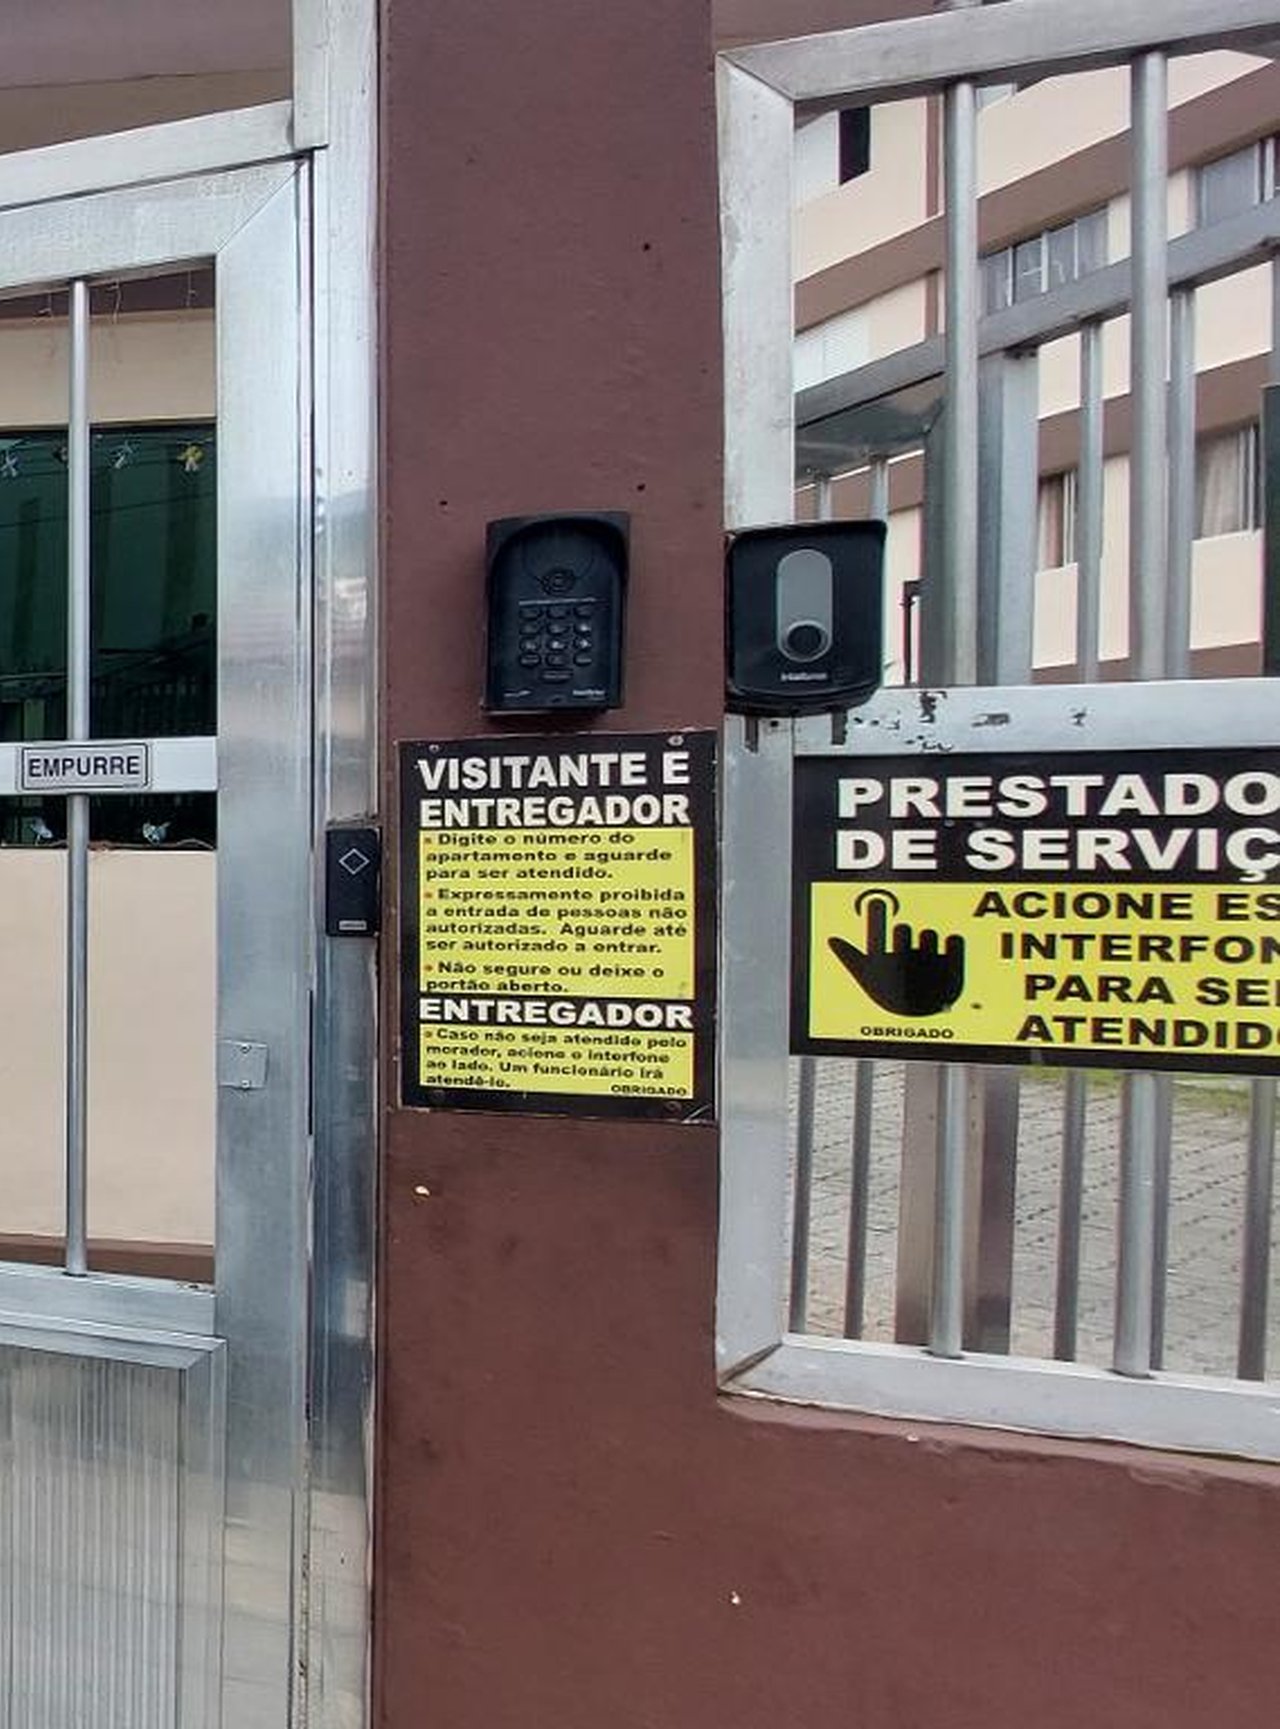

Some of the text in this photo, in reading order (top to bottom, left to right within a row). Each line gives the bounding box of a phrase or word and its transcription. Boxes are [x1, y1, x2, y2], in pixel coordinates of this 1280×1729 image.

[28, 756, 140, 777] EMPURRE
[418, 752, 690, 790] VISITANTE E
[837, 772, 1280, 818] PRESTADO
[420, 795, 690, 827] ENTREGADOR
[438, 832, 635, 846] Digite o número do
[426, 851, 557, 864] apartamento
[584, 850, 672, 863] aguarde
[836, 828, 1280, 882] DE SERVIÇ
[426, 867, 613, 882] para ser atendido.
[438, 889, 685, 903] Expressamente proibida
[426, 907, 687, 920] a entrada de pessoas não
[973, 891, 1193, 920] ACIONE
[426, 923, 687, 937] autorizadas. Aguarde até
[426, 940, 662, 953] ser autorizado a entrar.
[438, 962, 664, 978] Não segure ou deixe o
[426, 979, 568, 992] portão aberto.
[1024, 974, 1280, 1006] PARA SE
[420, 999, 693, 1029] ENTREGADOR
[437, 1029, 687, 1049] Caso não seja atendido pelo
[860, 1025, 954, 1039] OBRIGADO
[1015, 1015, 1280, 1051] ATENDID
[426, 1045, 501, 1059] morador,
[507, 1048, 565, 1059] acione
[588, 1051, 670, 1063] interfone
[426, 1061, 446, 1069] ao
[452, 1060, 492, 1072] lado.
[500, 1063, 527, 1073] Um
[533, 1064, 633, 1078] funcionário
[611, 1084, 687, 1096] OBRIGADO
